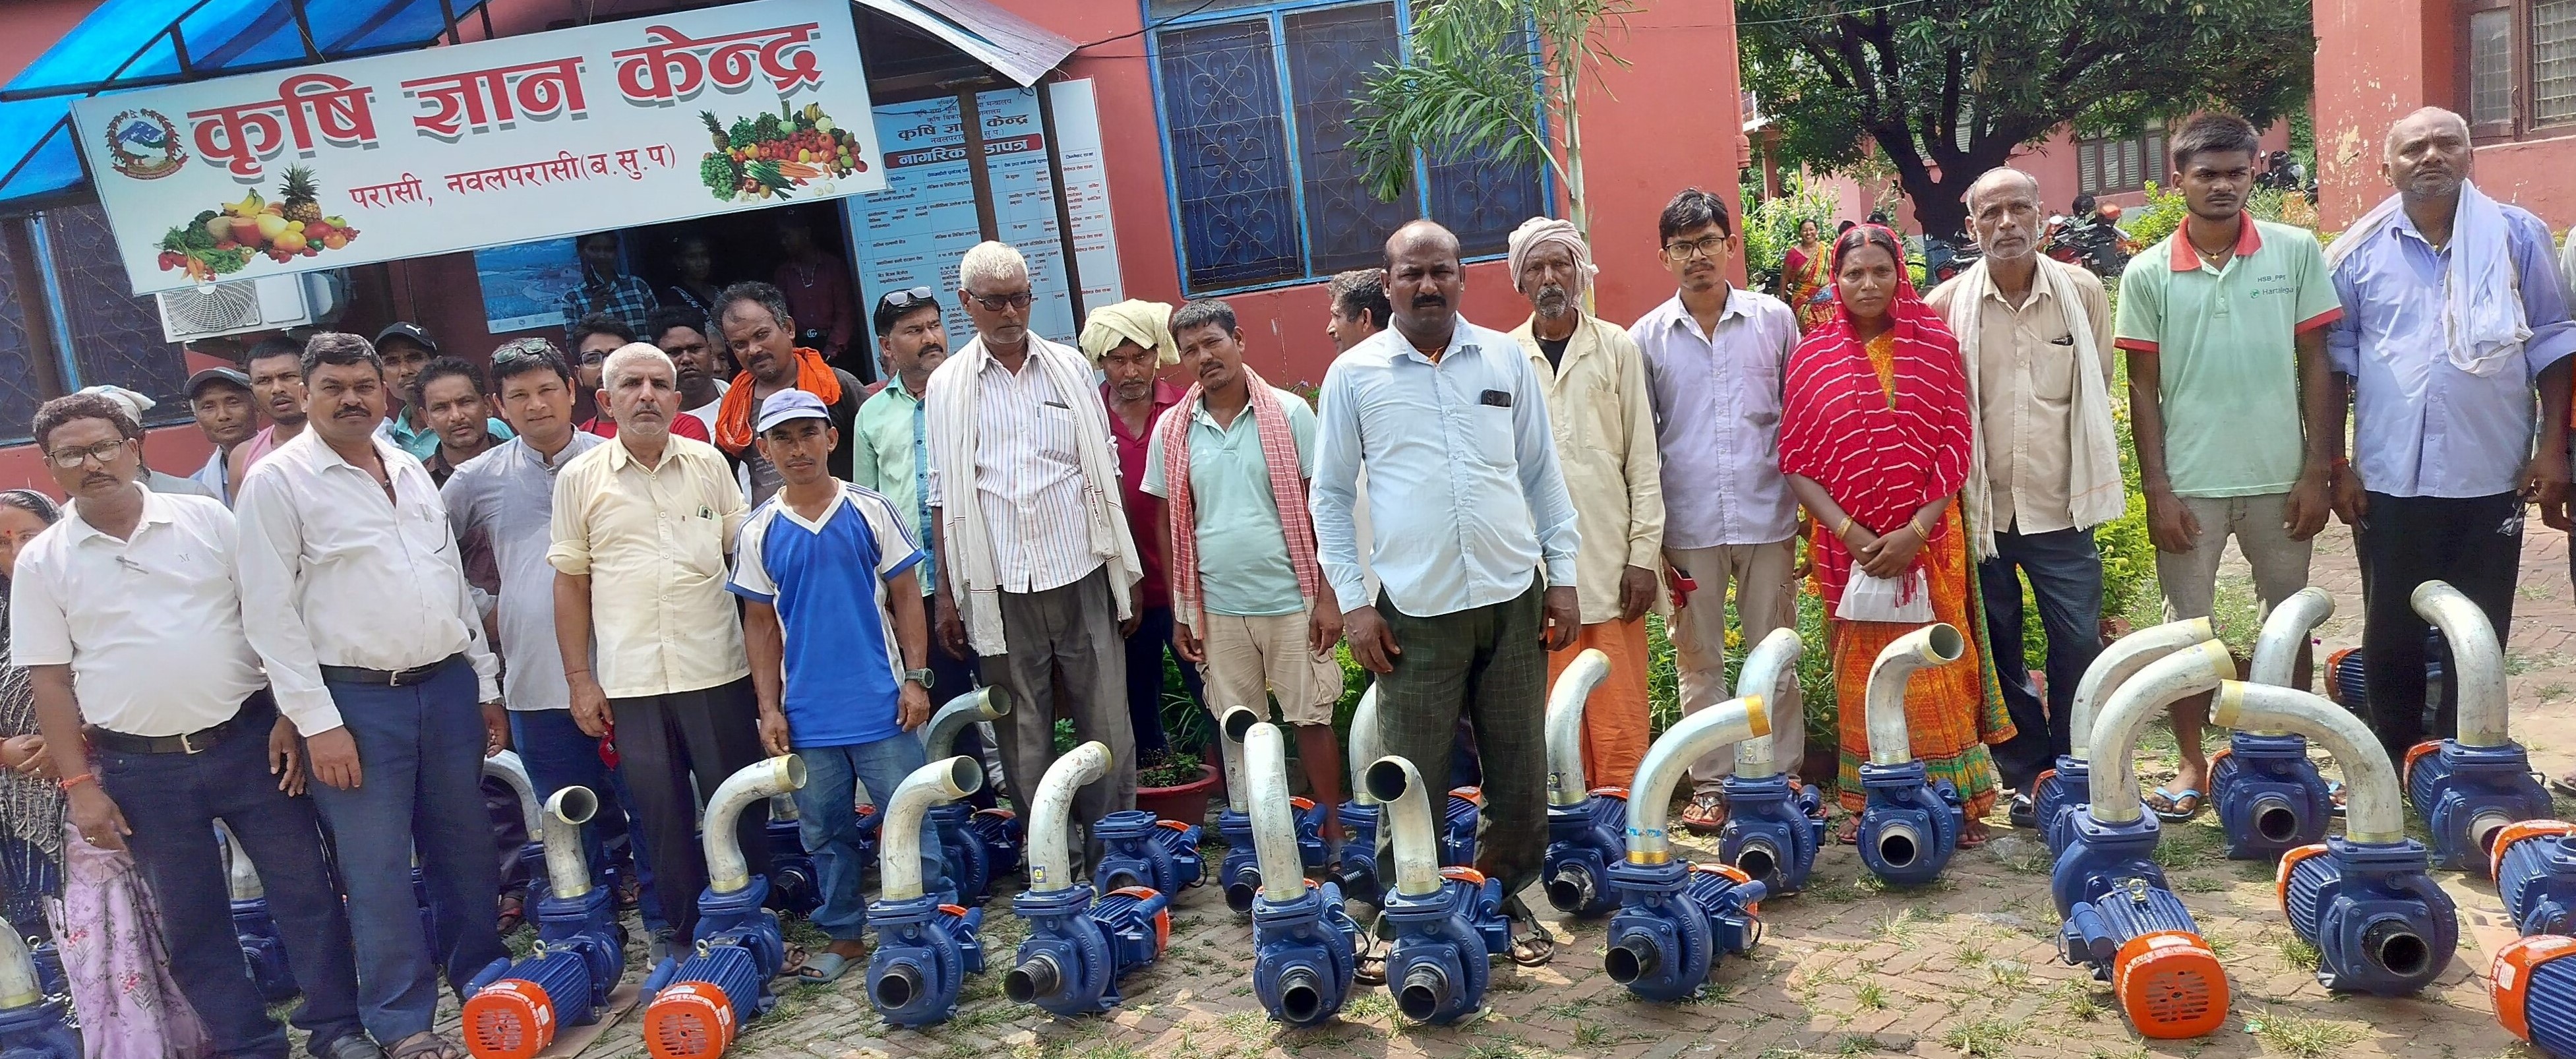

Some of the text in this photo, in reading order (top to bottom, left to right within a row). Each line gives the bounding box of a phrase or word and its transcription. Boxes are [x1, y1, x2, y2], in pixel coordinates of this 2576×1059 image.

[186, 21, 823, 178] कृषि ज्ञान केन्द्र
[897, 114, 1030, 141] कृषि ज्ञा केन्द्र
[897, 139, 1029, 165] नागरिक डापत्र
[2262, 287, 2294, 295] Hartalega
